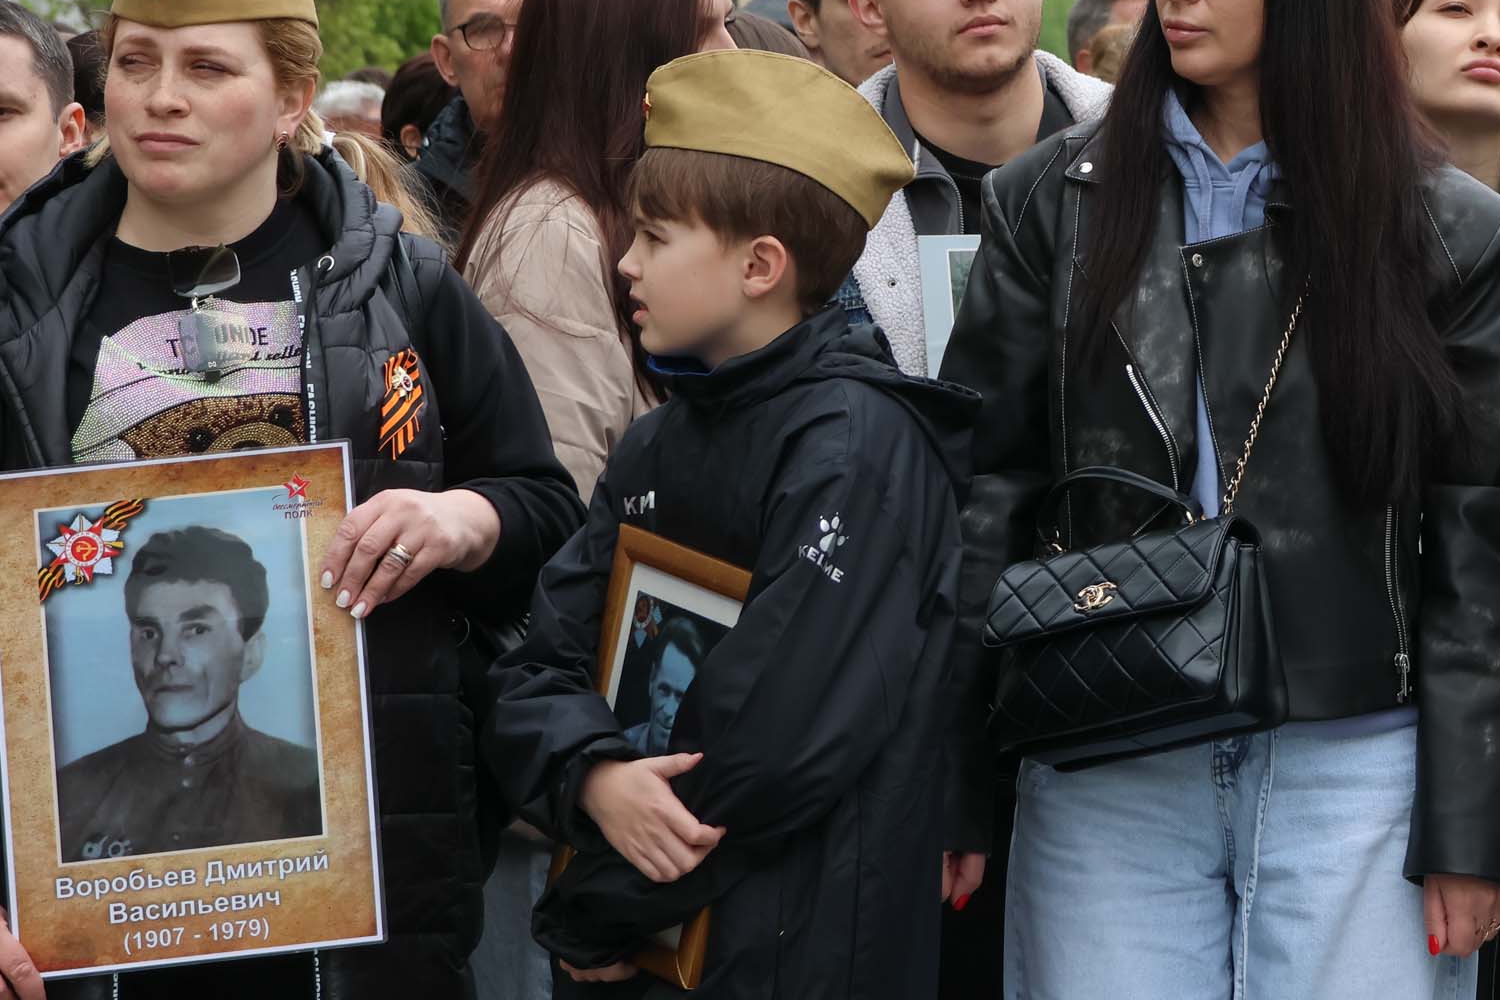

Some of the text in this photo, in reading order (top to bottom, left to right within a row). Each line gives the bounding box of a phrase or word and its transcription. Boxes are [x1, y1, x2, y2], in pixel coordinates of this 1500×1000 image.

[284, 509, 313, 519] ПОЛК
[55, 850, 329, 900] Воробьев Дмитрий
[109, 889, 281, 925] Васильевич
[123, 927, 186, 956] (1907
[208, 917, 270, 950] 1979)
